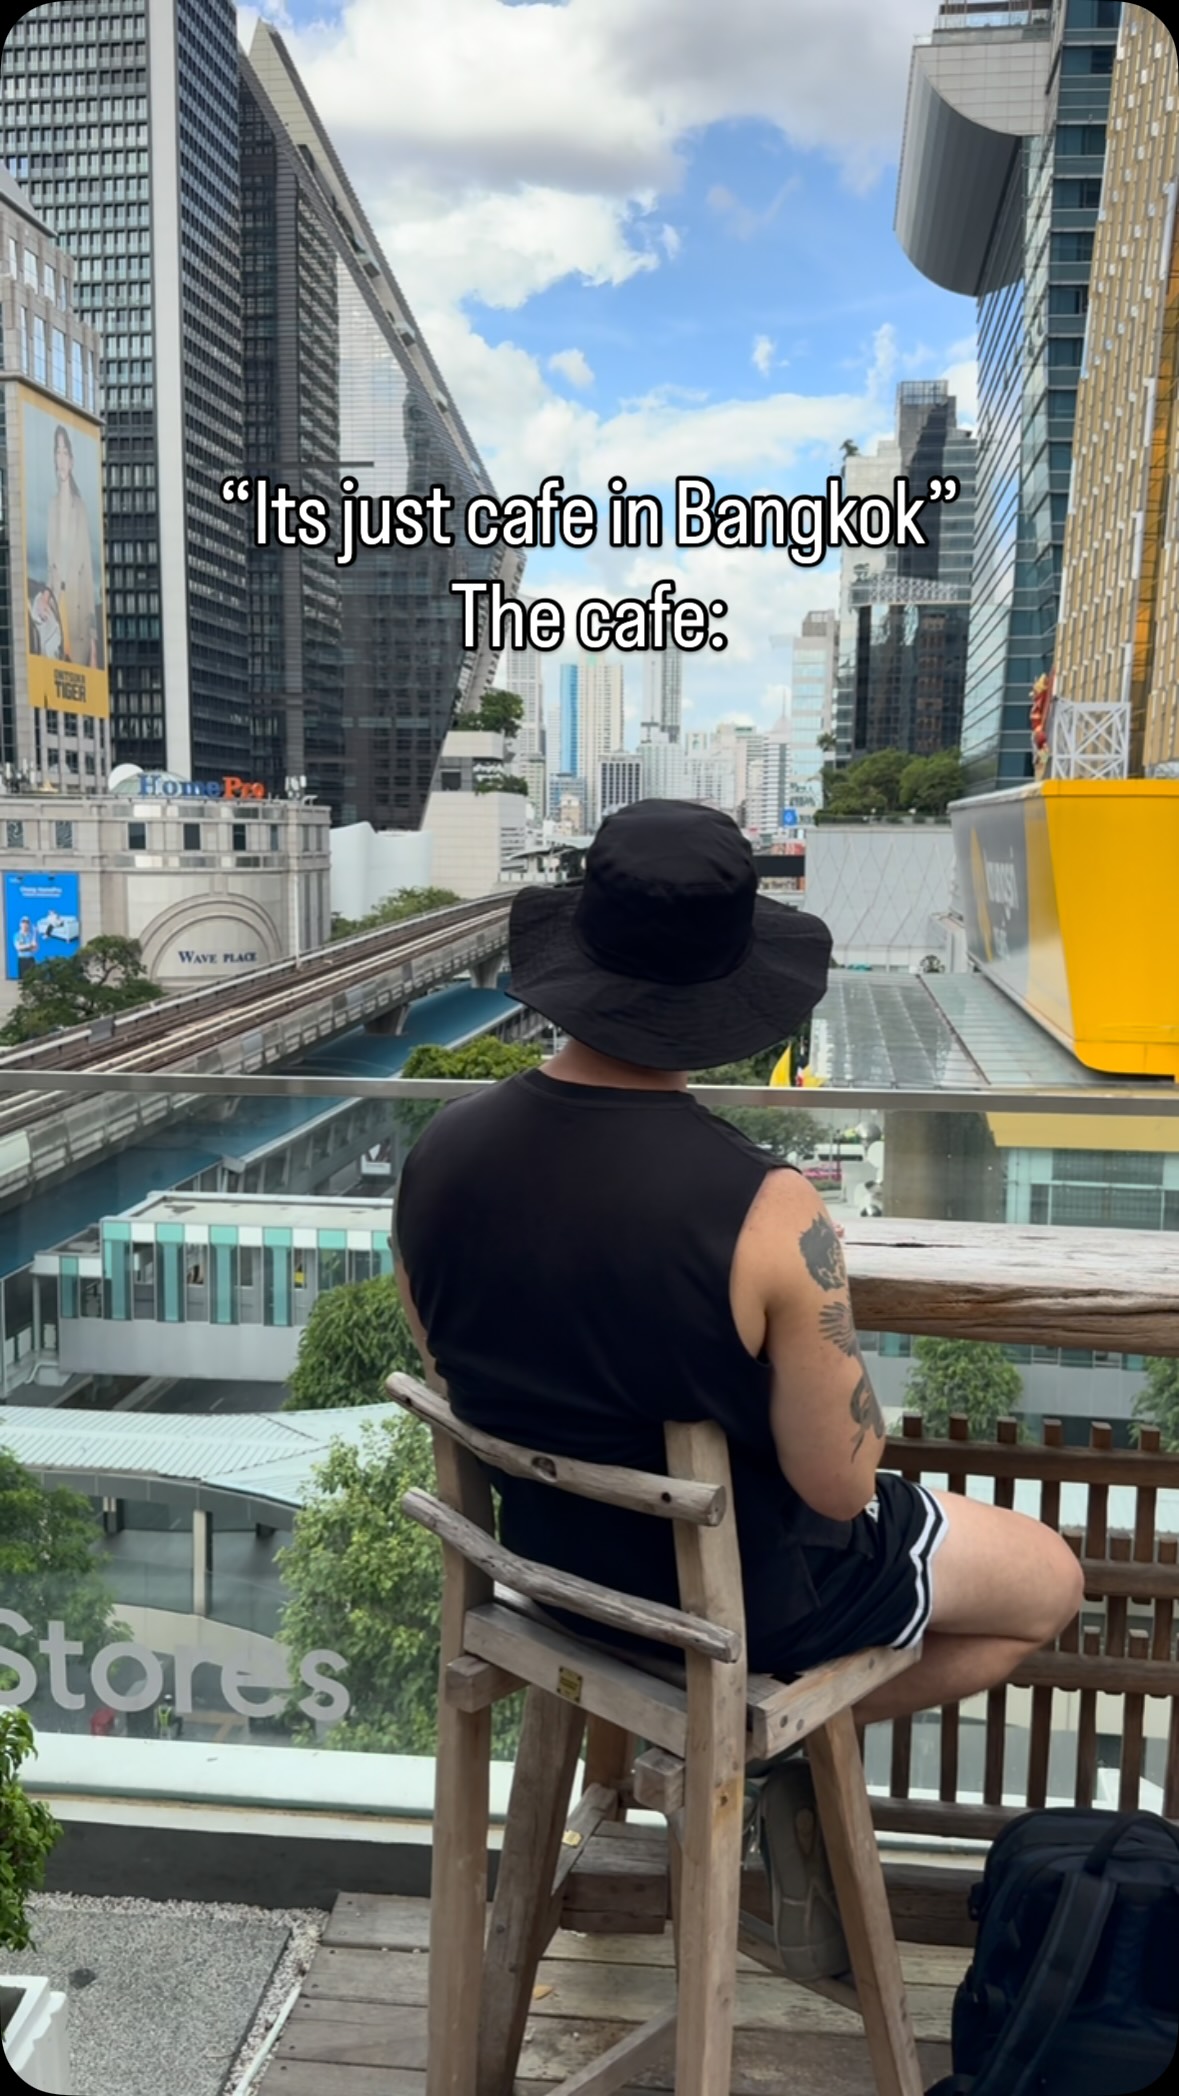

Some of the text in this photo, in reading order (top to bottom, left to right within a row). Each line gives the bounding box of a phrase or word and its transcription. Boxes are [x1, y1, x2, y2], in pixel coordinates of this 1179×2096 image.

[54, 680, 87, 703] TIGER
[138, 773, 265, 801] HomePro
[178, 950, 257, 964] WAVE PLACE
[0, 1607, 350, 1722] Stores
